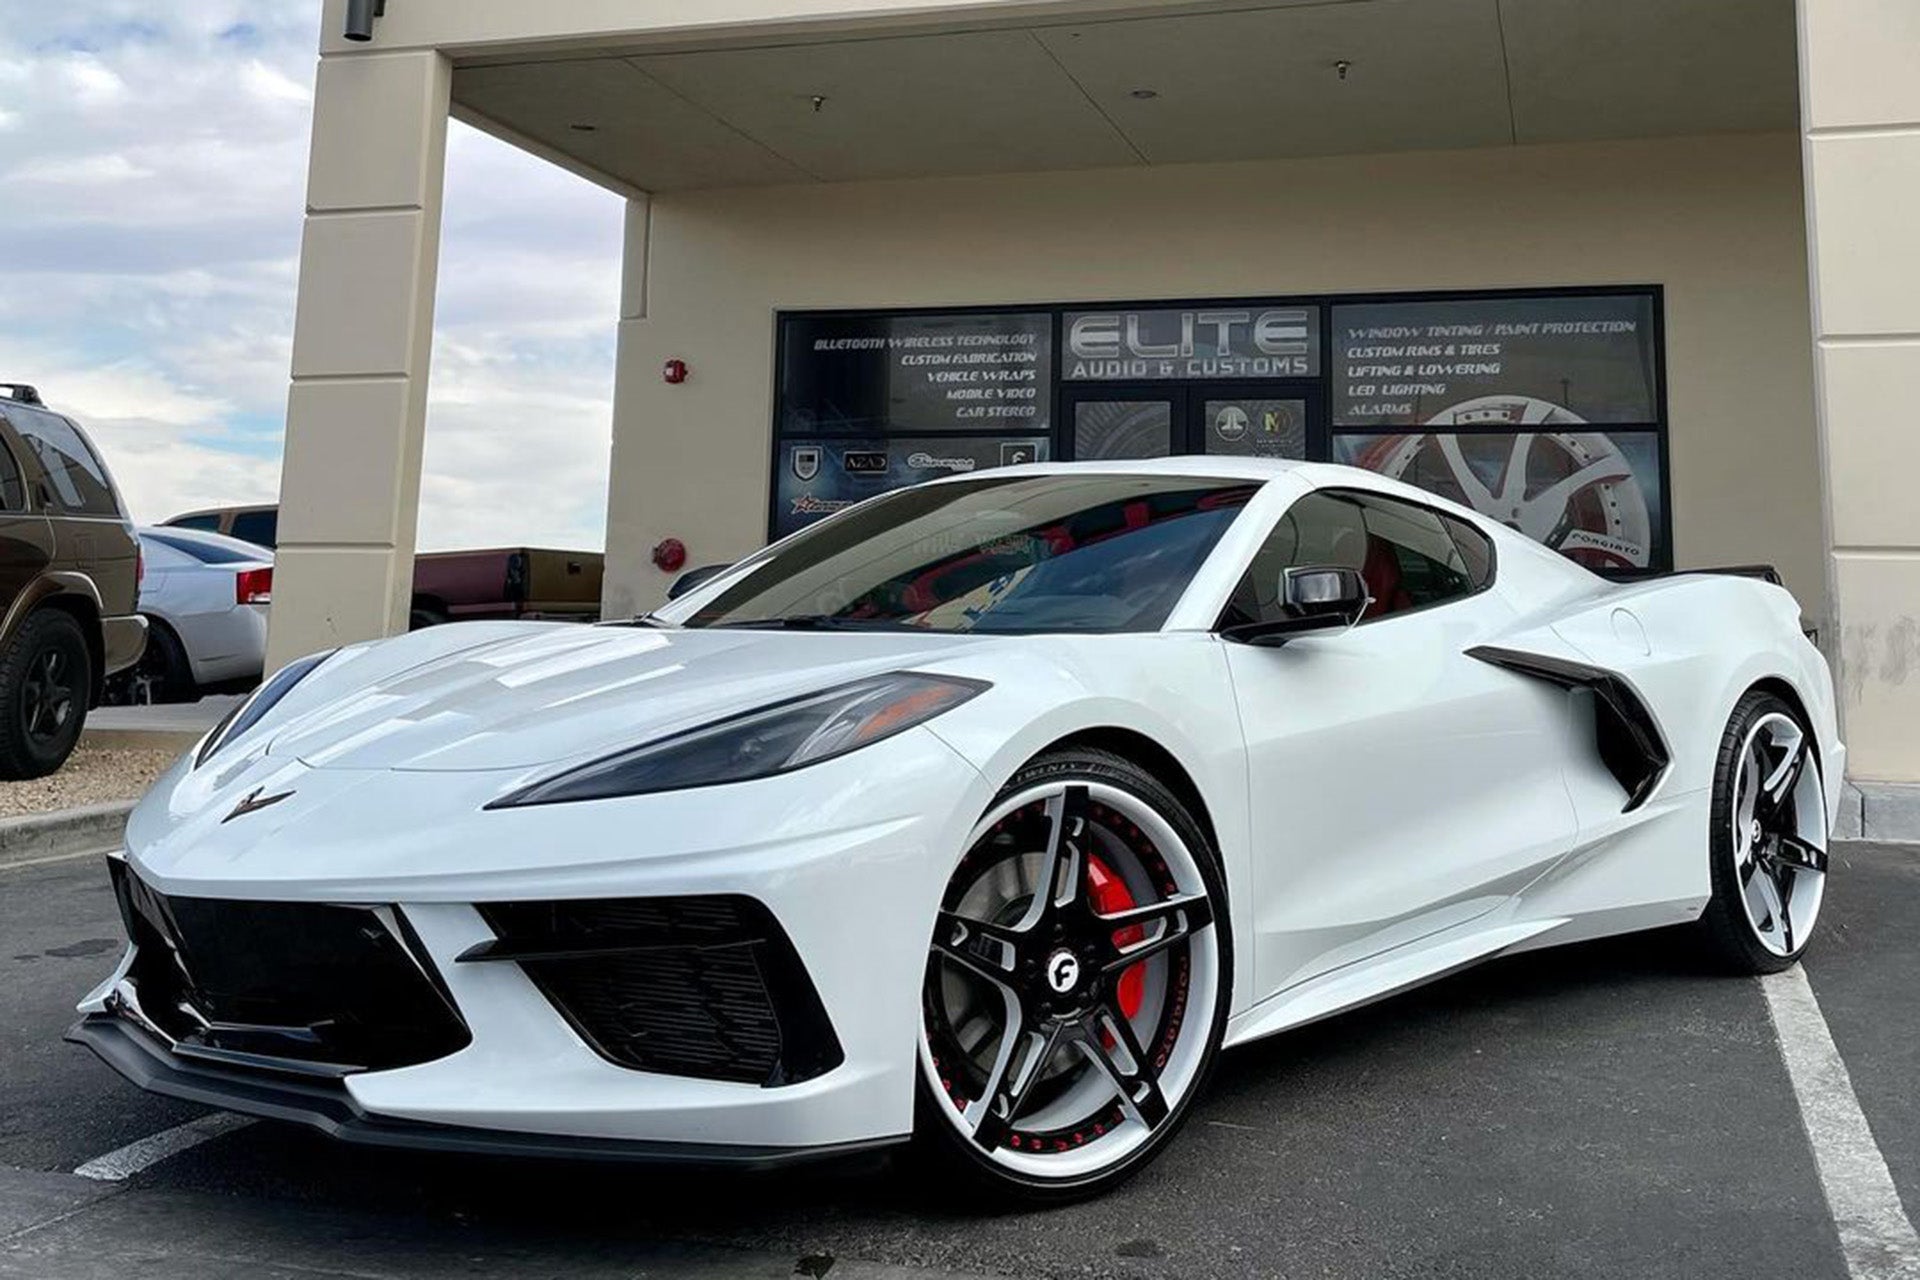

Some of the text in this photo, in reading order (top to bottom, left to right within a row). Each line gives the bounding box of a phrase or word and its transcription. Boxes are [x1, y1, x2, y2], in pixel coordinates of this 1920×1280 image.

[1070, 310, 1308, 358] ELITE
[1348, 328, 1422, 339] WINDOW
[1426, 325, 1483, 337] TINTING
[1494, 323, 1540, 336] PAINT
[1541, 320, 1637, 334] PROTECTION
[814, 333, 1036, 350] BLUETOOTH WIRELESS TECHNOLOGY
[1347, 343, 1501, 358] CUSTOM RIMS & TIRES
[902, 351, 1037, 366] CUSTOM FABRICATION
[1070, 356, 1309, 378] AUDIO & CUSTOMS
[1348, 362, 1501, 378] LIFTING & LOWERING
[926, 369, 1036, 383] VEHICLE WRAPS
[947, 387, 1036, 400] MOBILE VIDEO
[1348, 383, 1446, 396] LED LIGHTING
[956, 405, 1036, 418] CAR STEREO
[1348, 403, 1412, 415] ALARMS
[1572, 532, 1640, 556] FORGIATO
